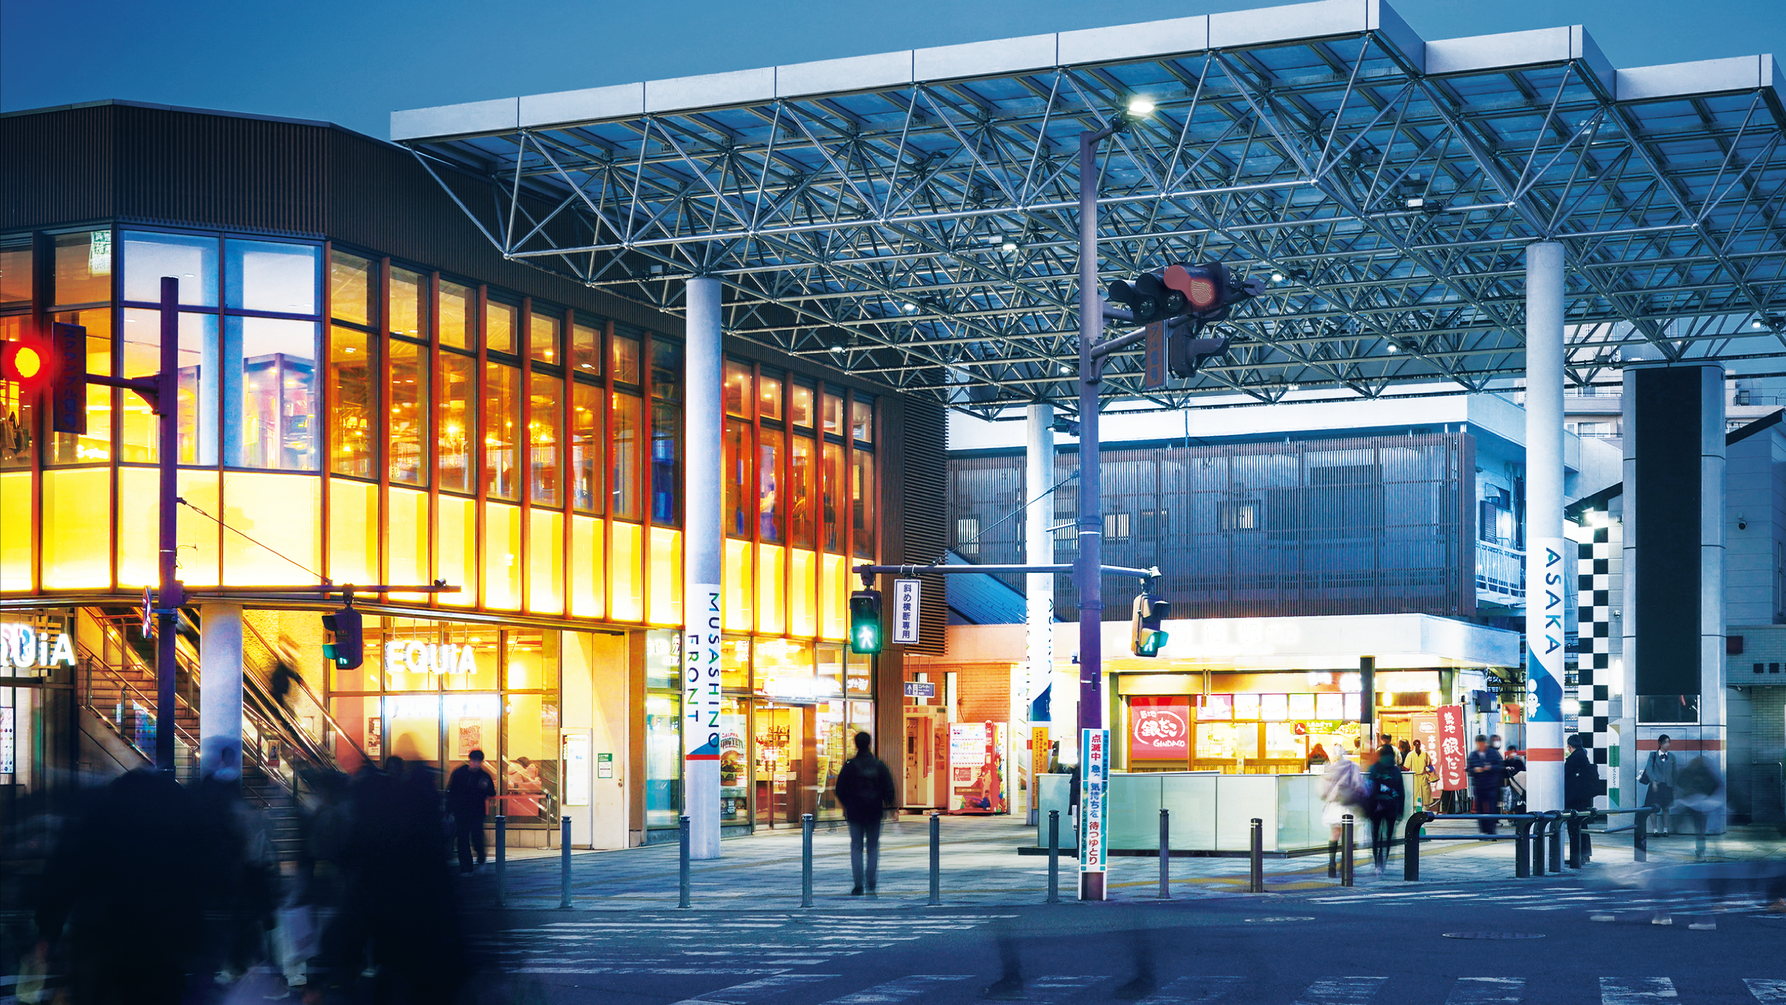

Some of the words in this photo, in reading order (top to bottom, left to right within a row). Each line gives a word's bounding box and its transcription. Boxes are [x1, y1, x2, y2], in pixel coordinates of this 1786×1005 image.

[902, 583, 912, 639] 斜め横断専用
[1545, 547, 1562, 655] ASAKA
[687, 634, 699, 722] FRONT
[708, 592, 720, 749] MUSASHINO
[1091, 733, 1102, 761] 点滅中
[1141, 717, 1178, 738] 銀だこ
[1442, 736, 1463, 786] 銀だこ
[1089, 783, 1101, 818] 気持ちを
[1088, 821, 1100, 865] 待つゆとり
